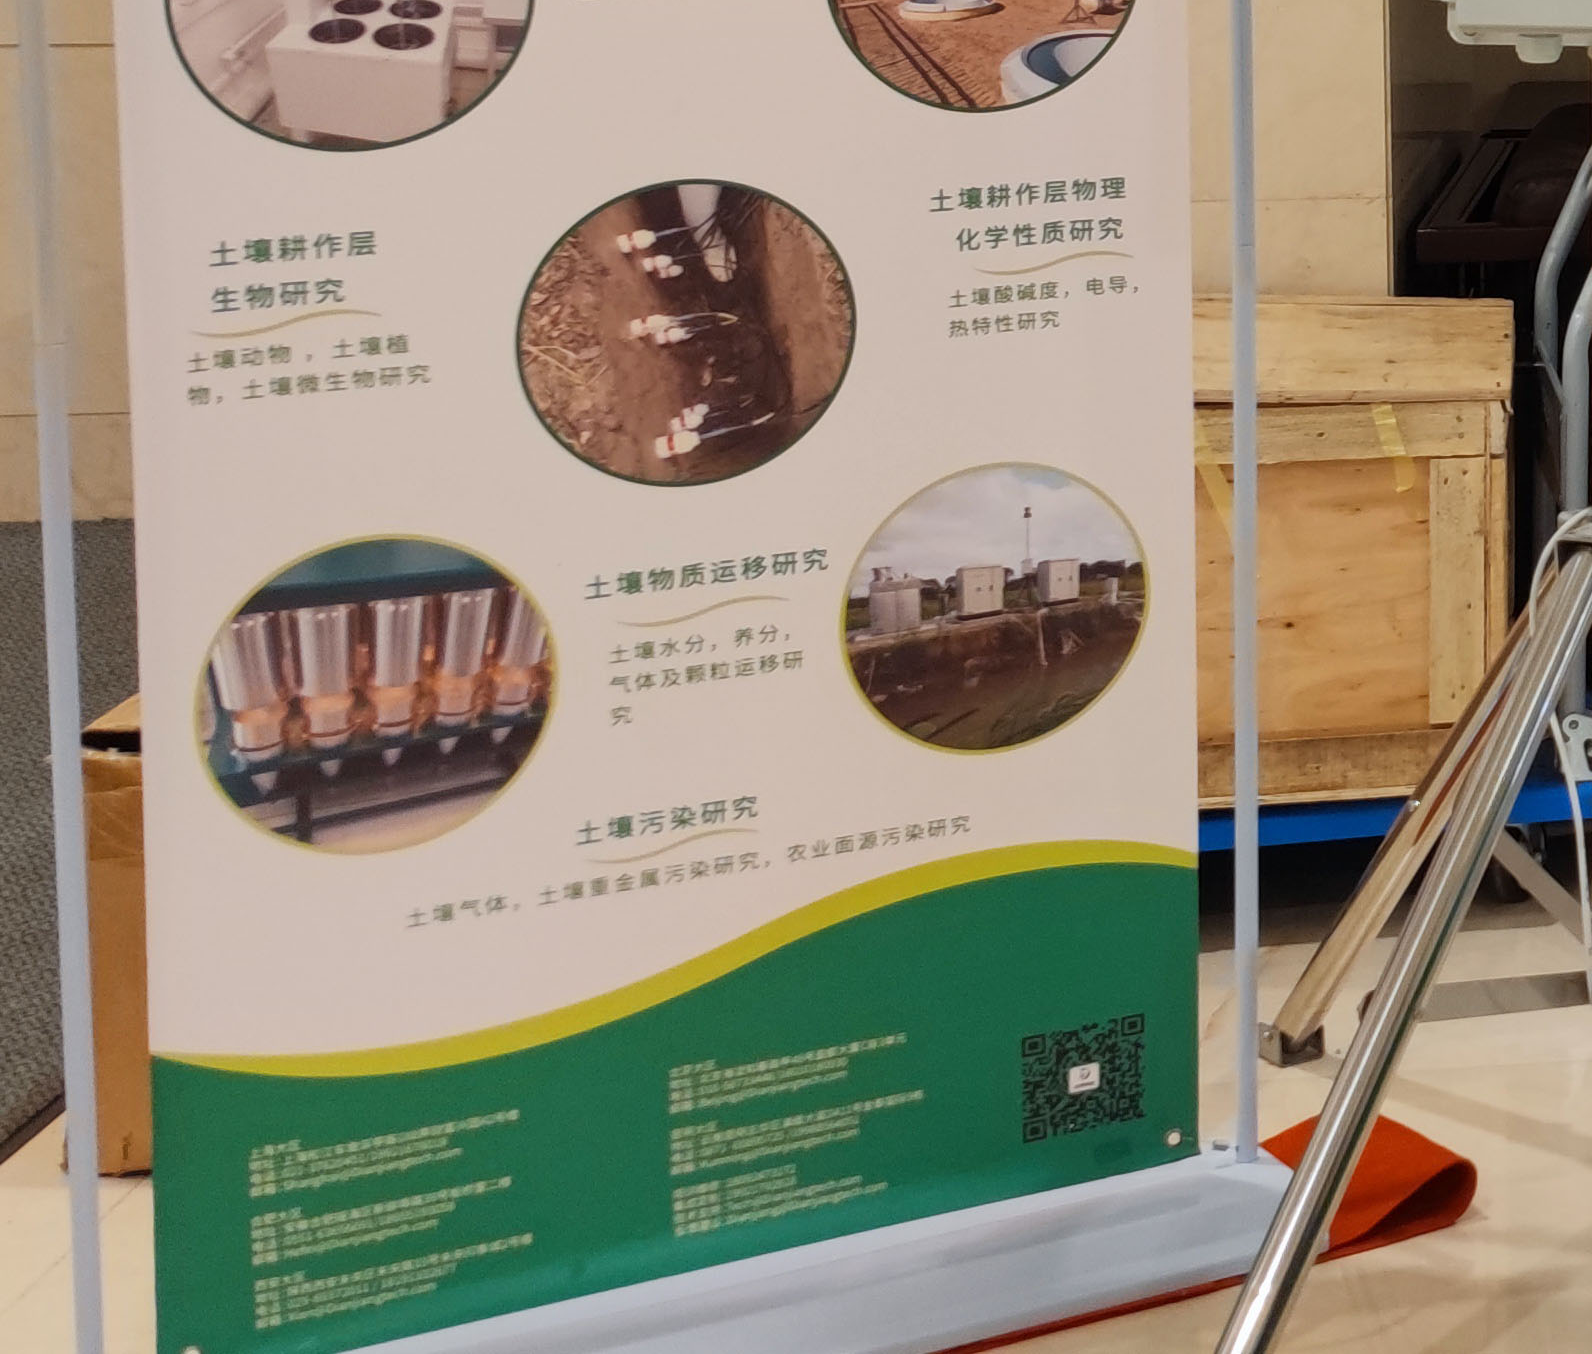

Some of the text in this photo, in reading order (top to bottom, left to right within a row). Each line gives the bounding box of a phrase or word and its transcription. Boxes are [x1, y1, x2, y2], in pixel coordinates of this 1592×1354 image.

[929, 177, 1127, 213] 土壤耕作层物理
[209, 230, 378, 267] 土壤耕作层
[956, 217, 1124, 252] 化学性质研究
[211, 278, 346, 313] 生物研究
[947, 275, 1141, 308] 土壤酸碱度，电导，
[947, 310, 1061, 339] 热特性研究
[187, 333, 410, 374] 土壤动物，土壤植
[187, 364, 432, 406] 物，土壤微生物研究
[584, 549, 829, 600] 土壤物质运移研究
[609, 650, 804, 693] 气体及颗粒运移研
[609, 705, 633, 726] 究
[576, 796, 759, 846] 土壤污染研究
